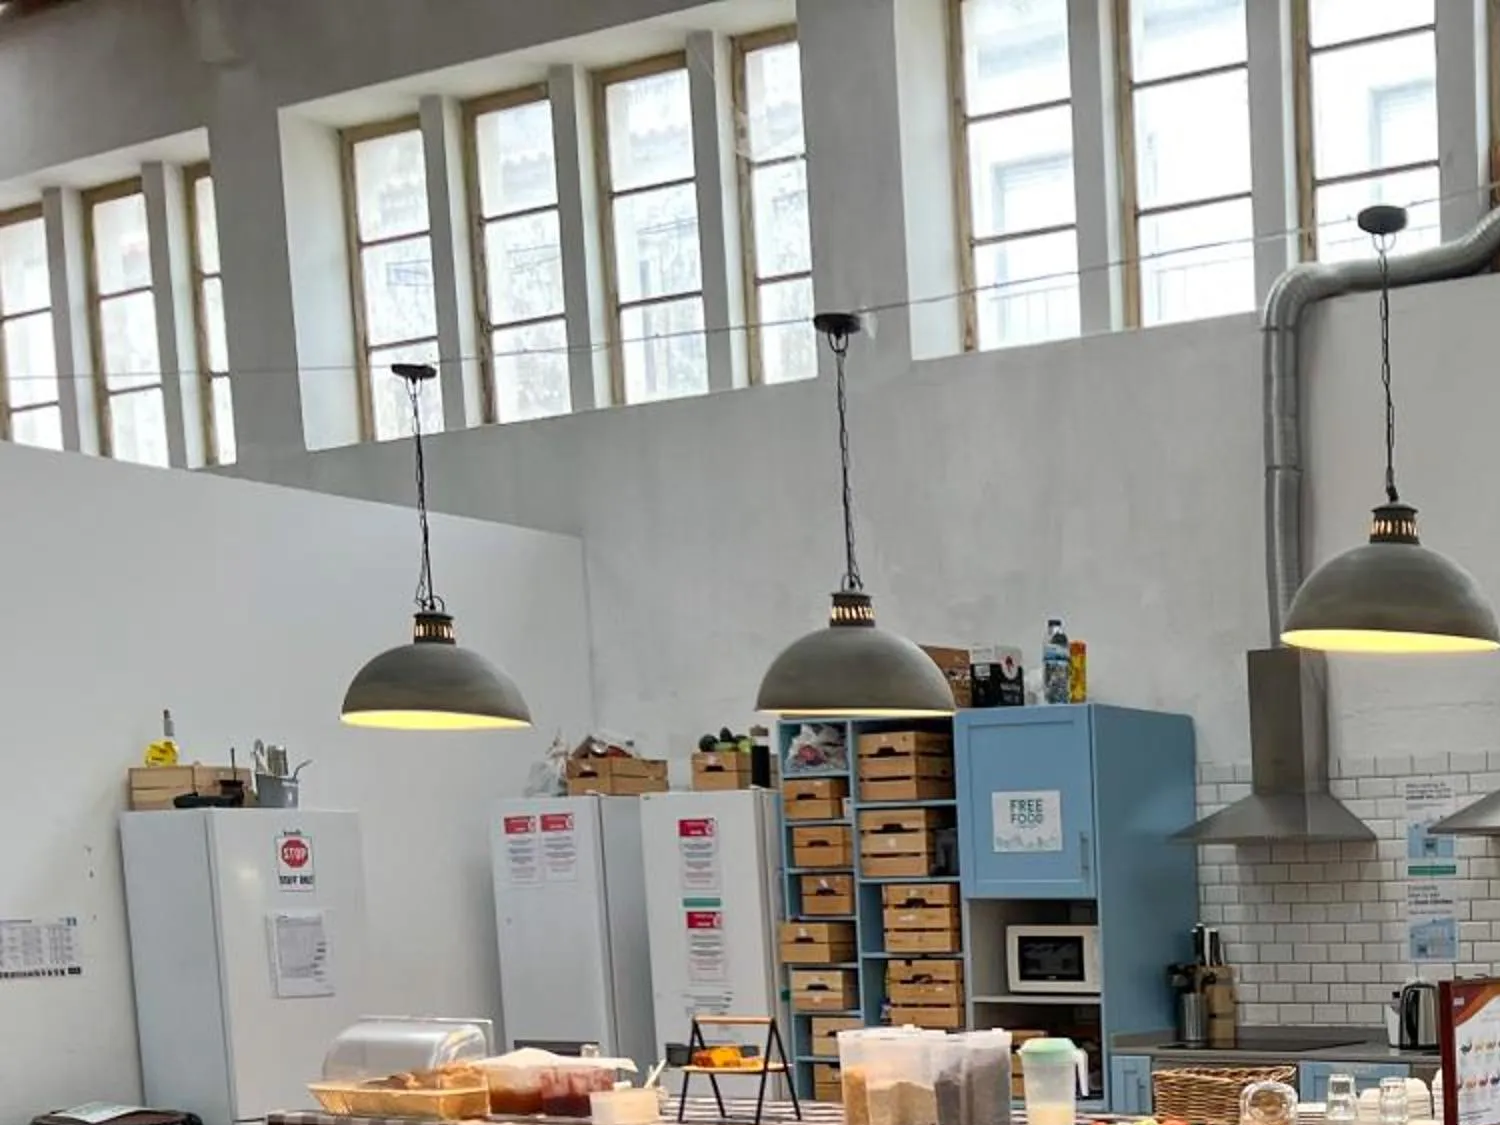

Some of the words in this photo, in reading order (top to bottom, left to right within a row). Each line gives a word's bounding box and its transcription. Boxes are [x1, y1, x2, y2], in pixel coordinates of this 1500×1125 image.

[1009, 799, 1043, 812] FREE
[1011, 813, 1043, 824] FOOD
[283, 847, 306, 860] STOP
